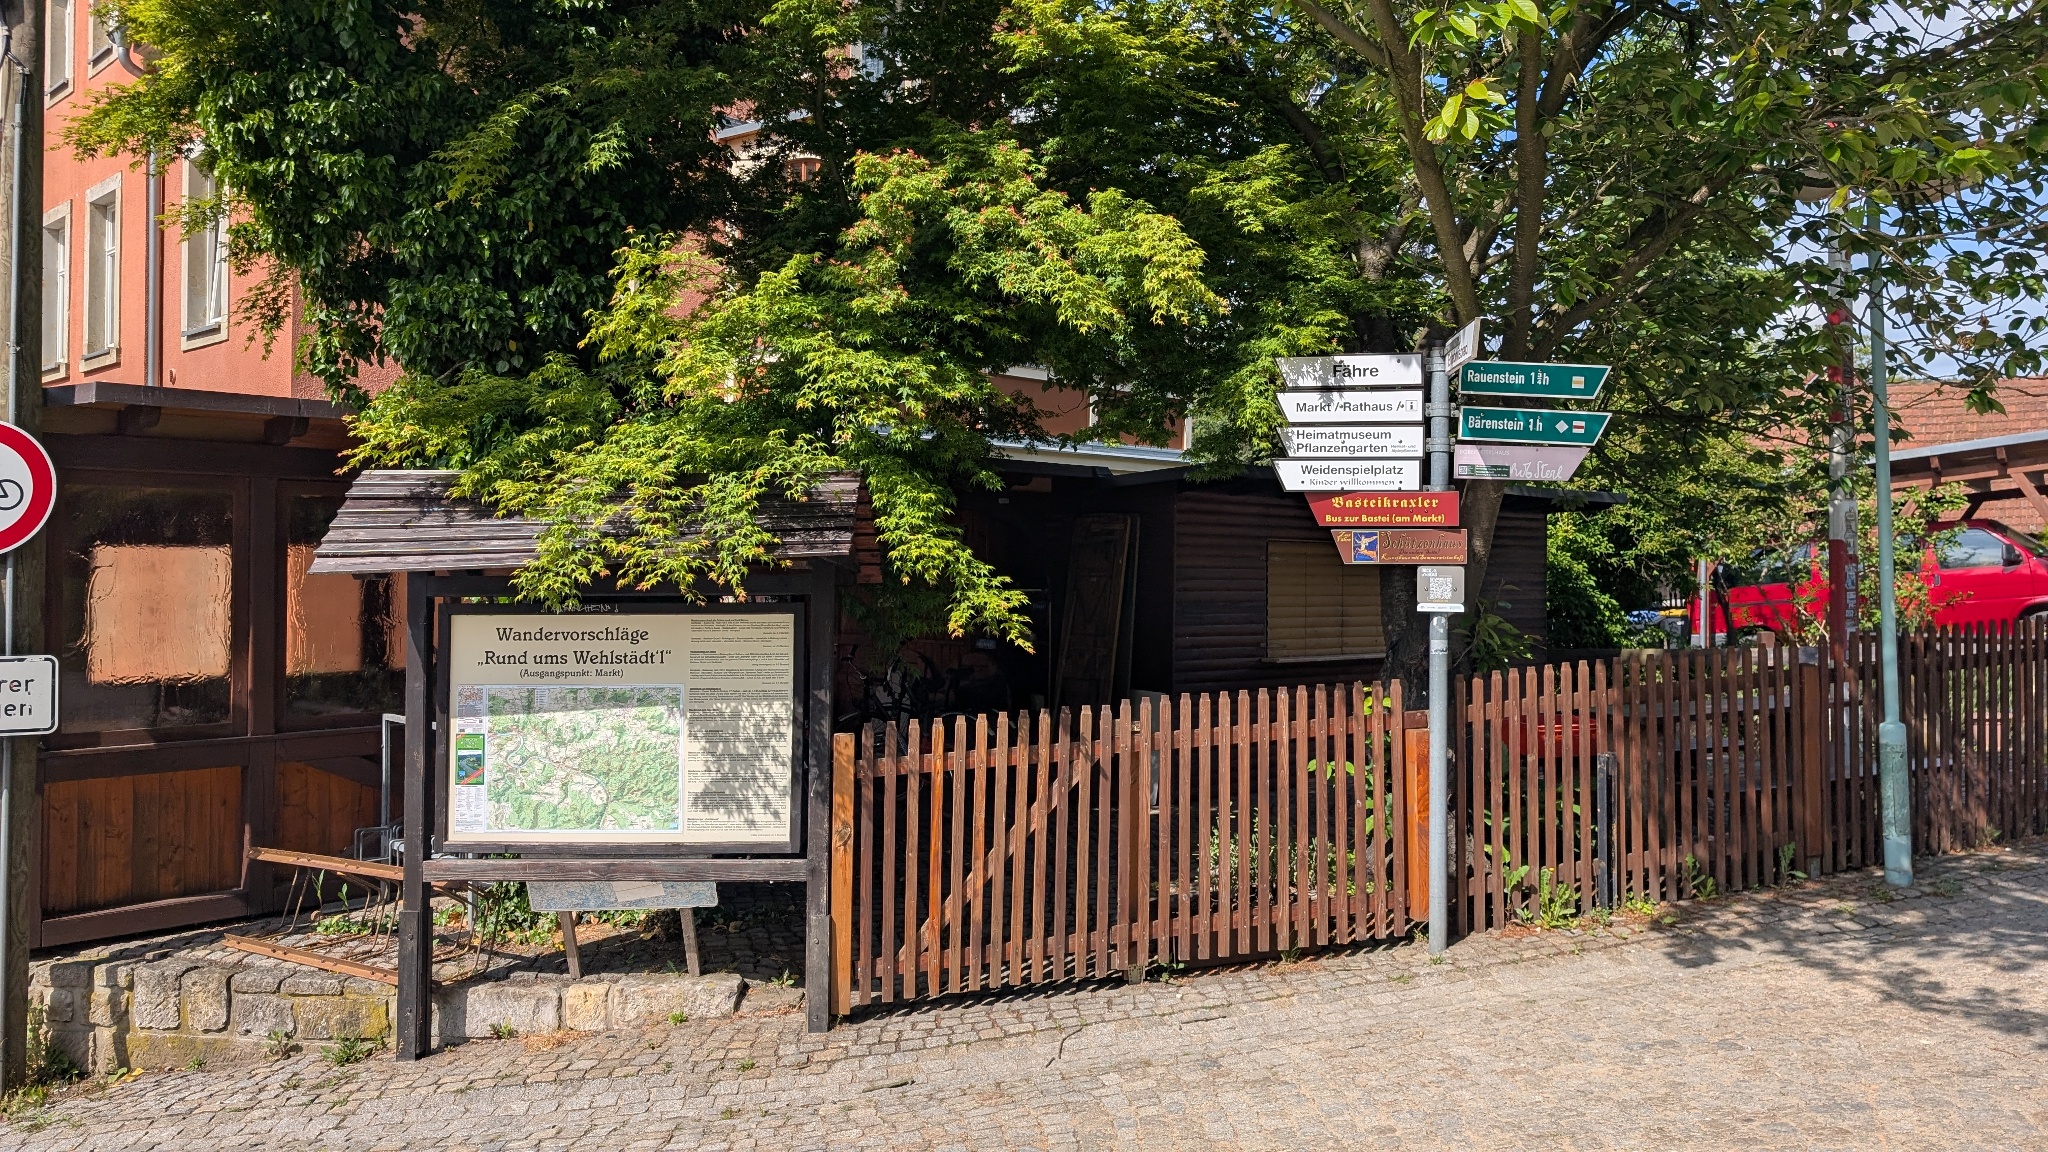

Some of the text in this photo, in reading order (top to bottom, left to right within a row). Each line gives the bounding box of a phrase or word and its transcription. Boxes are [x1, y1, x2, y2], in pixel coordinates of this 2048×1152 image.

[1332, 364, 1379, 378] Fähre
[1467, 369, 1525, 385] Rauenstein
[1296, 402, 1332, 412] Markt
[1343, 402, 1393, 412] Rathaus
[1468, 415, 1524, 431] Bärenstein
[1296, 429, 1392, 440] Heimatmuseum
[1296, 443, 1388, 455] Pflanzengarten
[1301, 465, 1404, 476] Weidenspielplatz
[1309, 478, 1395, 486] Kinder willkommen
[1331, 496, 1439, 509] Basteikraxler
[1325, 514, 1342, 522] Bus
[1361, 514, 1390, 522] Bastei
[1392, 513, 1410, 524] (am
[1412, 513, 1445, 524] Markt)
[496, 626, 649, 645] Wandervorschläge
[477, 650, 528, 667] „Rund
[533, 654, 568, 665] ums
[519, 668, 624, 679] (Ausgangspunkt: Markt)
